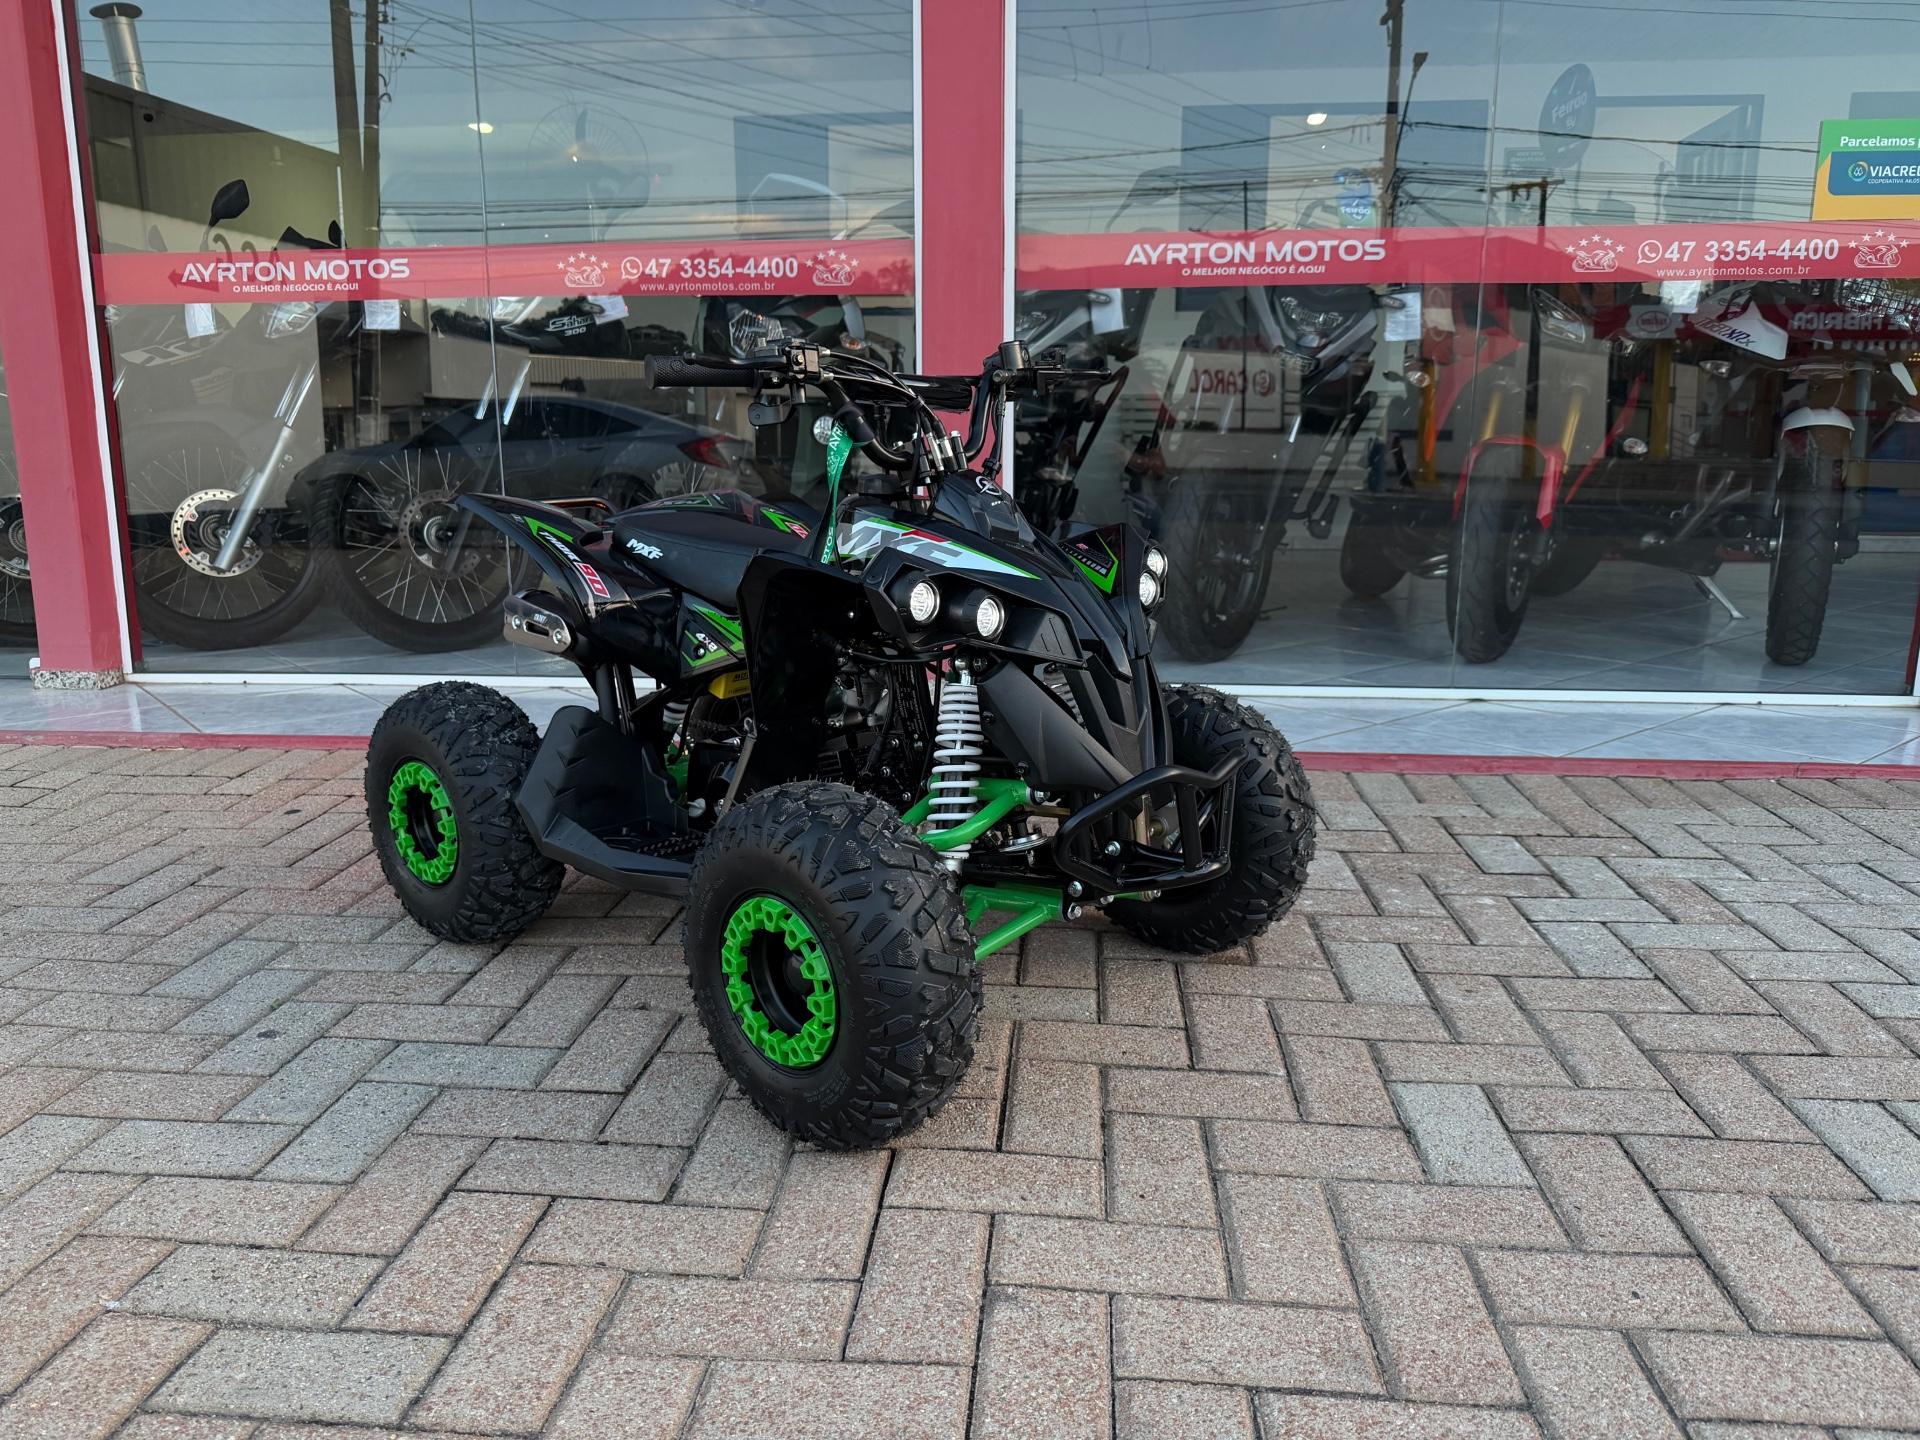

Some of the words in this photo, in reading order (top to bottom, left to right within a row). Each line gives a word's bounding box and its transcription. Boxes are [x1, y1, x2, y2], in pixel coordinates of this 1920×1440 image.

[1840, 135, 1915, 147] Parcelamos
[1124, 241, 1255, 266] AYRTON
[1265, 239, 1386, 262] MOTOS
[1664, 241, 1697, 263] 47
[1704, 238, 1840, 262] 3354-4400
[181, 261, 296, 283] AYRTON
[304, 257, 410, 281] MOTOS
[644, 257, 672, 278] 47
[679, 256, 799, 278] 3354-4400
[1181, 267, 1190, 276] O
[1192, 266, 1236, 276] MELHOR
[1238, 264, 1287, 275] NEGÓCIO
[1288, 264, 1296, 274] É
[1297, 265, 1326, 274] AQUI
[1656, 265, 1812, 279] www.ayrtonmotos.com.br
[233, 285, 241, 293] O
[242, 284, 281, 293] MELHOR
[282, 282, 326, 292] NEGÓCIO
[326, 281, 333, 291] É
[334, 282, 359, 291] AQUI
[639, 281, 776, 293] www.ayrtonmotos.com.br
[544, 314, 597, 332] Sahar
[564, 326, 587, 337] 300
[626, 538, 664, 560] MXF
[820, 525, 834, 564] OTOS
